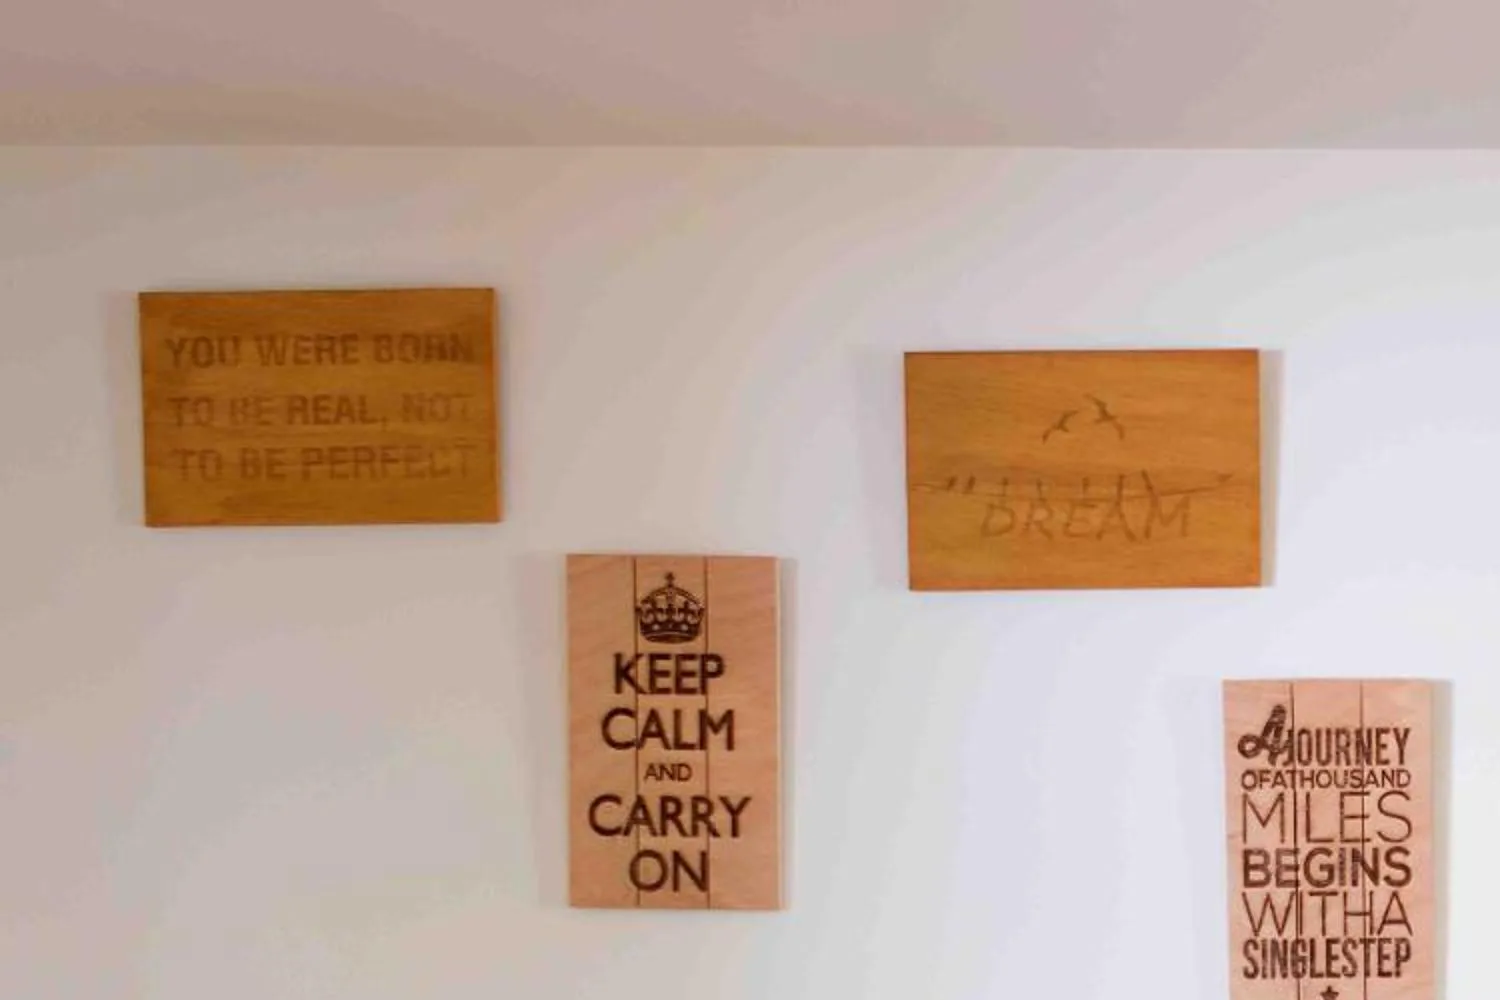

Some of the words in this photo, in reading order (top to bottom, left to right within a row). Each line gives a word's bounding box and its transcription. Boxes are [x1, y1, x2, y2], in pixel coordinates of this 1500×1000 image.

[165, 335, 241, 368] YOU
[254, 333, 360, 367] WERE
[373, 332, 475, 364] BORN
[169, 396, 214, 427] TO
[287, 394, 388, 431] REAL,
[402, 392, 476, 424] NOT
[179, 449, 222, 482] TO
[240, 447, 287, 481] BE
[300, 445, 476, 481] PERFECT
[980, 495, 1191, 543] DREAM
[614, 653, 725, 695] KEEP
[602, 708, 735, 751] CALM
[1283, 728, 1411, 767] JOURNEY
[643, 763, 694, 781] AND
[588, 795, 752, 838] CARRY
[1242, 792, 1413, 843] MILES
[629, 850, 708, 892] ON
[1243, 848, 1412, 888] BEGINS
